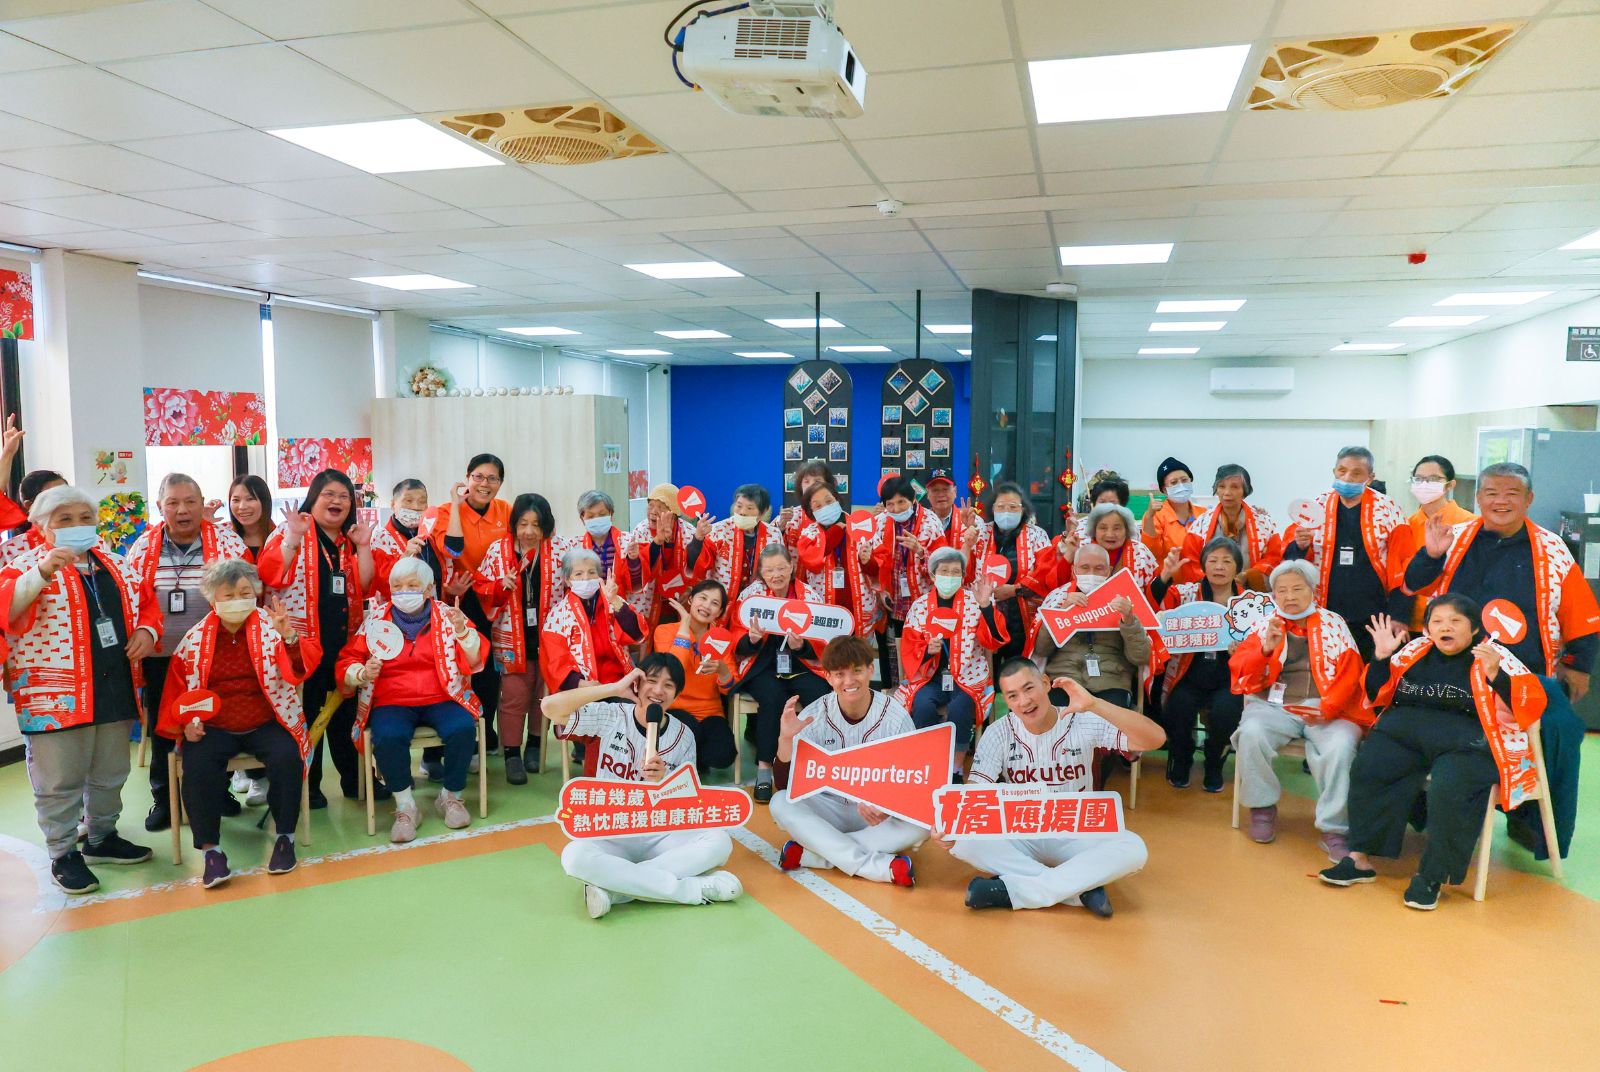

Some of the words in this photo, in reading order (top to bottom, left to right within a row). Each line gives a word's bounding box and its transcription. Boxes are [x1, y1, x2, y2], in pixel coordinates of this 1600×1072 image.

[1055, 617, 1071, 630] Be
[1073, 595, 1134, 624] support!
[1166, 615, 1222, 631] 健康支援
[1162, 632, 1218, 648] 如影隨形
[805, 759, 826, 779] Be
[831, 764, 930, 786] supporters!
[1007, 763, 1086, 784] Rakuten
[569, 787, 645, 806] 無論幾歲
[660, 782, 688, 796] supporters!
[1002, 788, 1008, 796] Be
[1010, 788, 1042, 797] supporters!
[573, 803, 741, 833] 熱忱應援健康新生活
